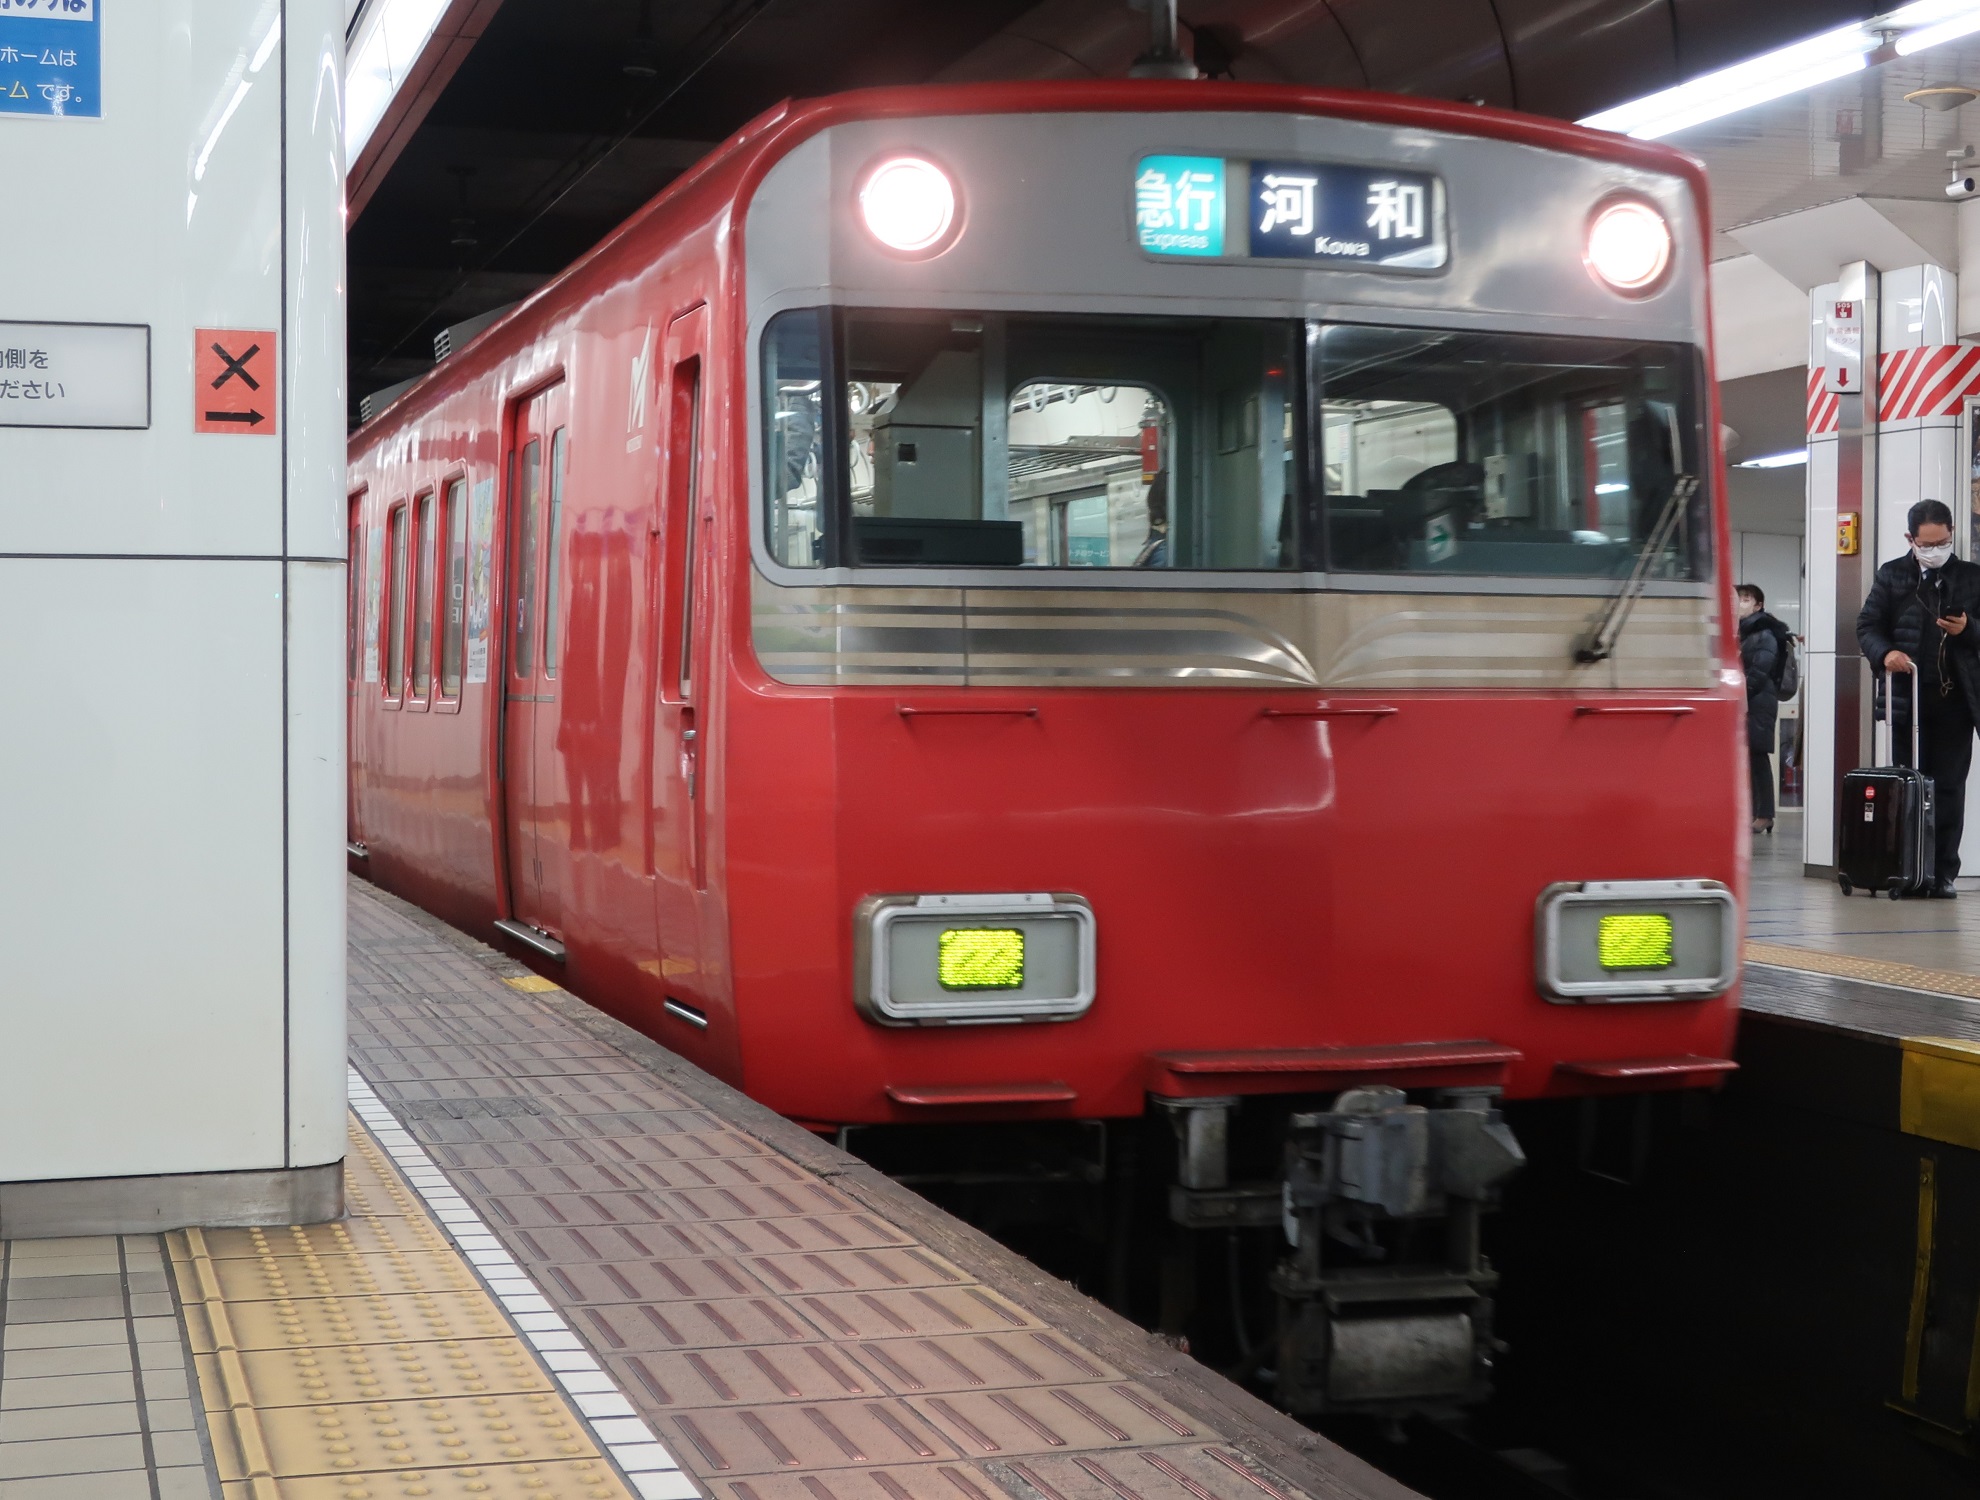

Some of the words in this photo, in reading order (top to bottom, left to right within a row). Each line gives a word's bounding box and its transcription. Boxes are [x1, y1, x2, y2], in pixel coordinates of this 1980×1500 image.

[0, 46, 78, 67] ホームは
[36, 84, 82, 103] です。
[1135, 168, 1217, 232] 急行
[1259, 173, 1425, 240] 河和
[1140, 229, 1210, 251] Express
[1315, 236, 1371, 257] Kowa
[0, 348, 49, 370] 側を
[0, 379, 65, 400] ださい
